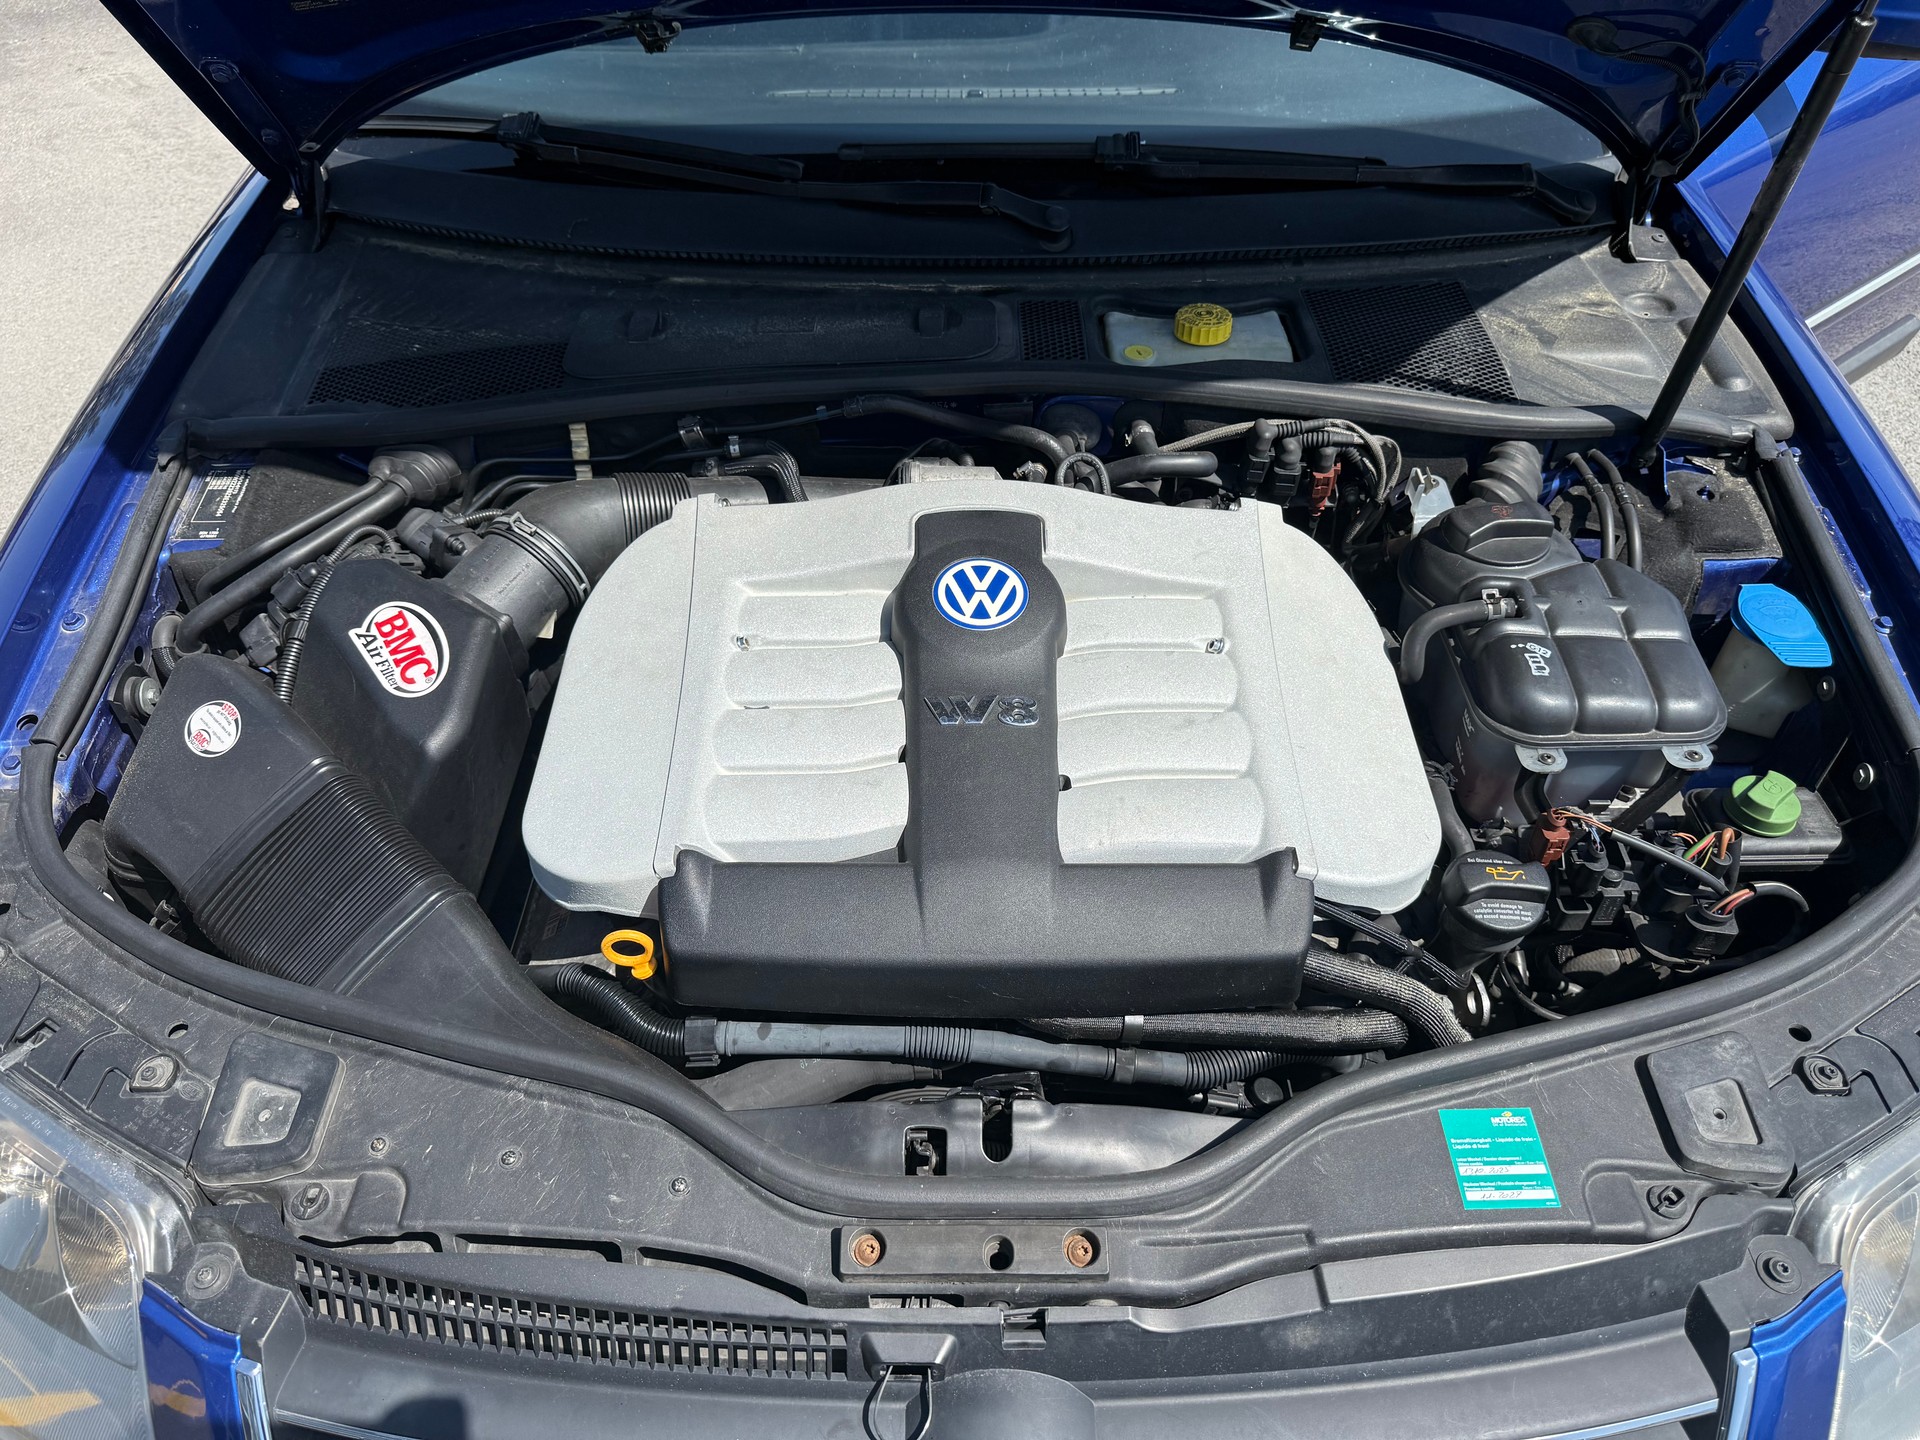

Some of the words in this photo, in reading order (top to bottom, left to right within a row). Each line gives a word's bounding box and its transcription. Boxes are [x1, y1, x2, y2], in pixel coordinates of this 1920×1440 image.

[936, 559, 1026, 629] VW
[355, 633, 384, 659] Air
[375, 659, 398, 687] Filter
[374, 610, 436, 684] BMC
[221, 703, 238, 720] STOP!
[923, 694, 1040, 726] W8
[193, 731, 209, 748] BMC
